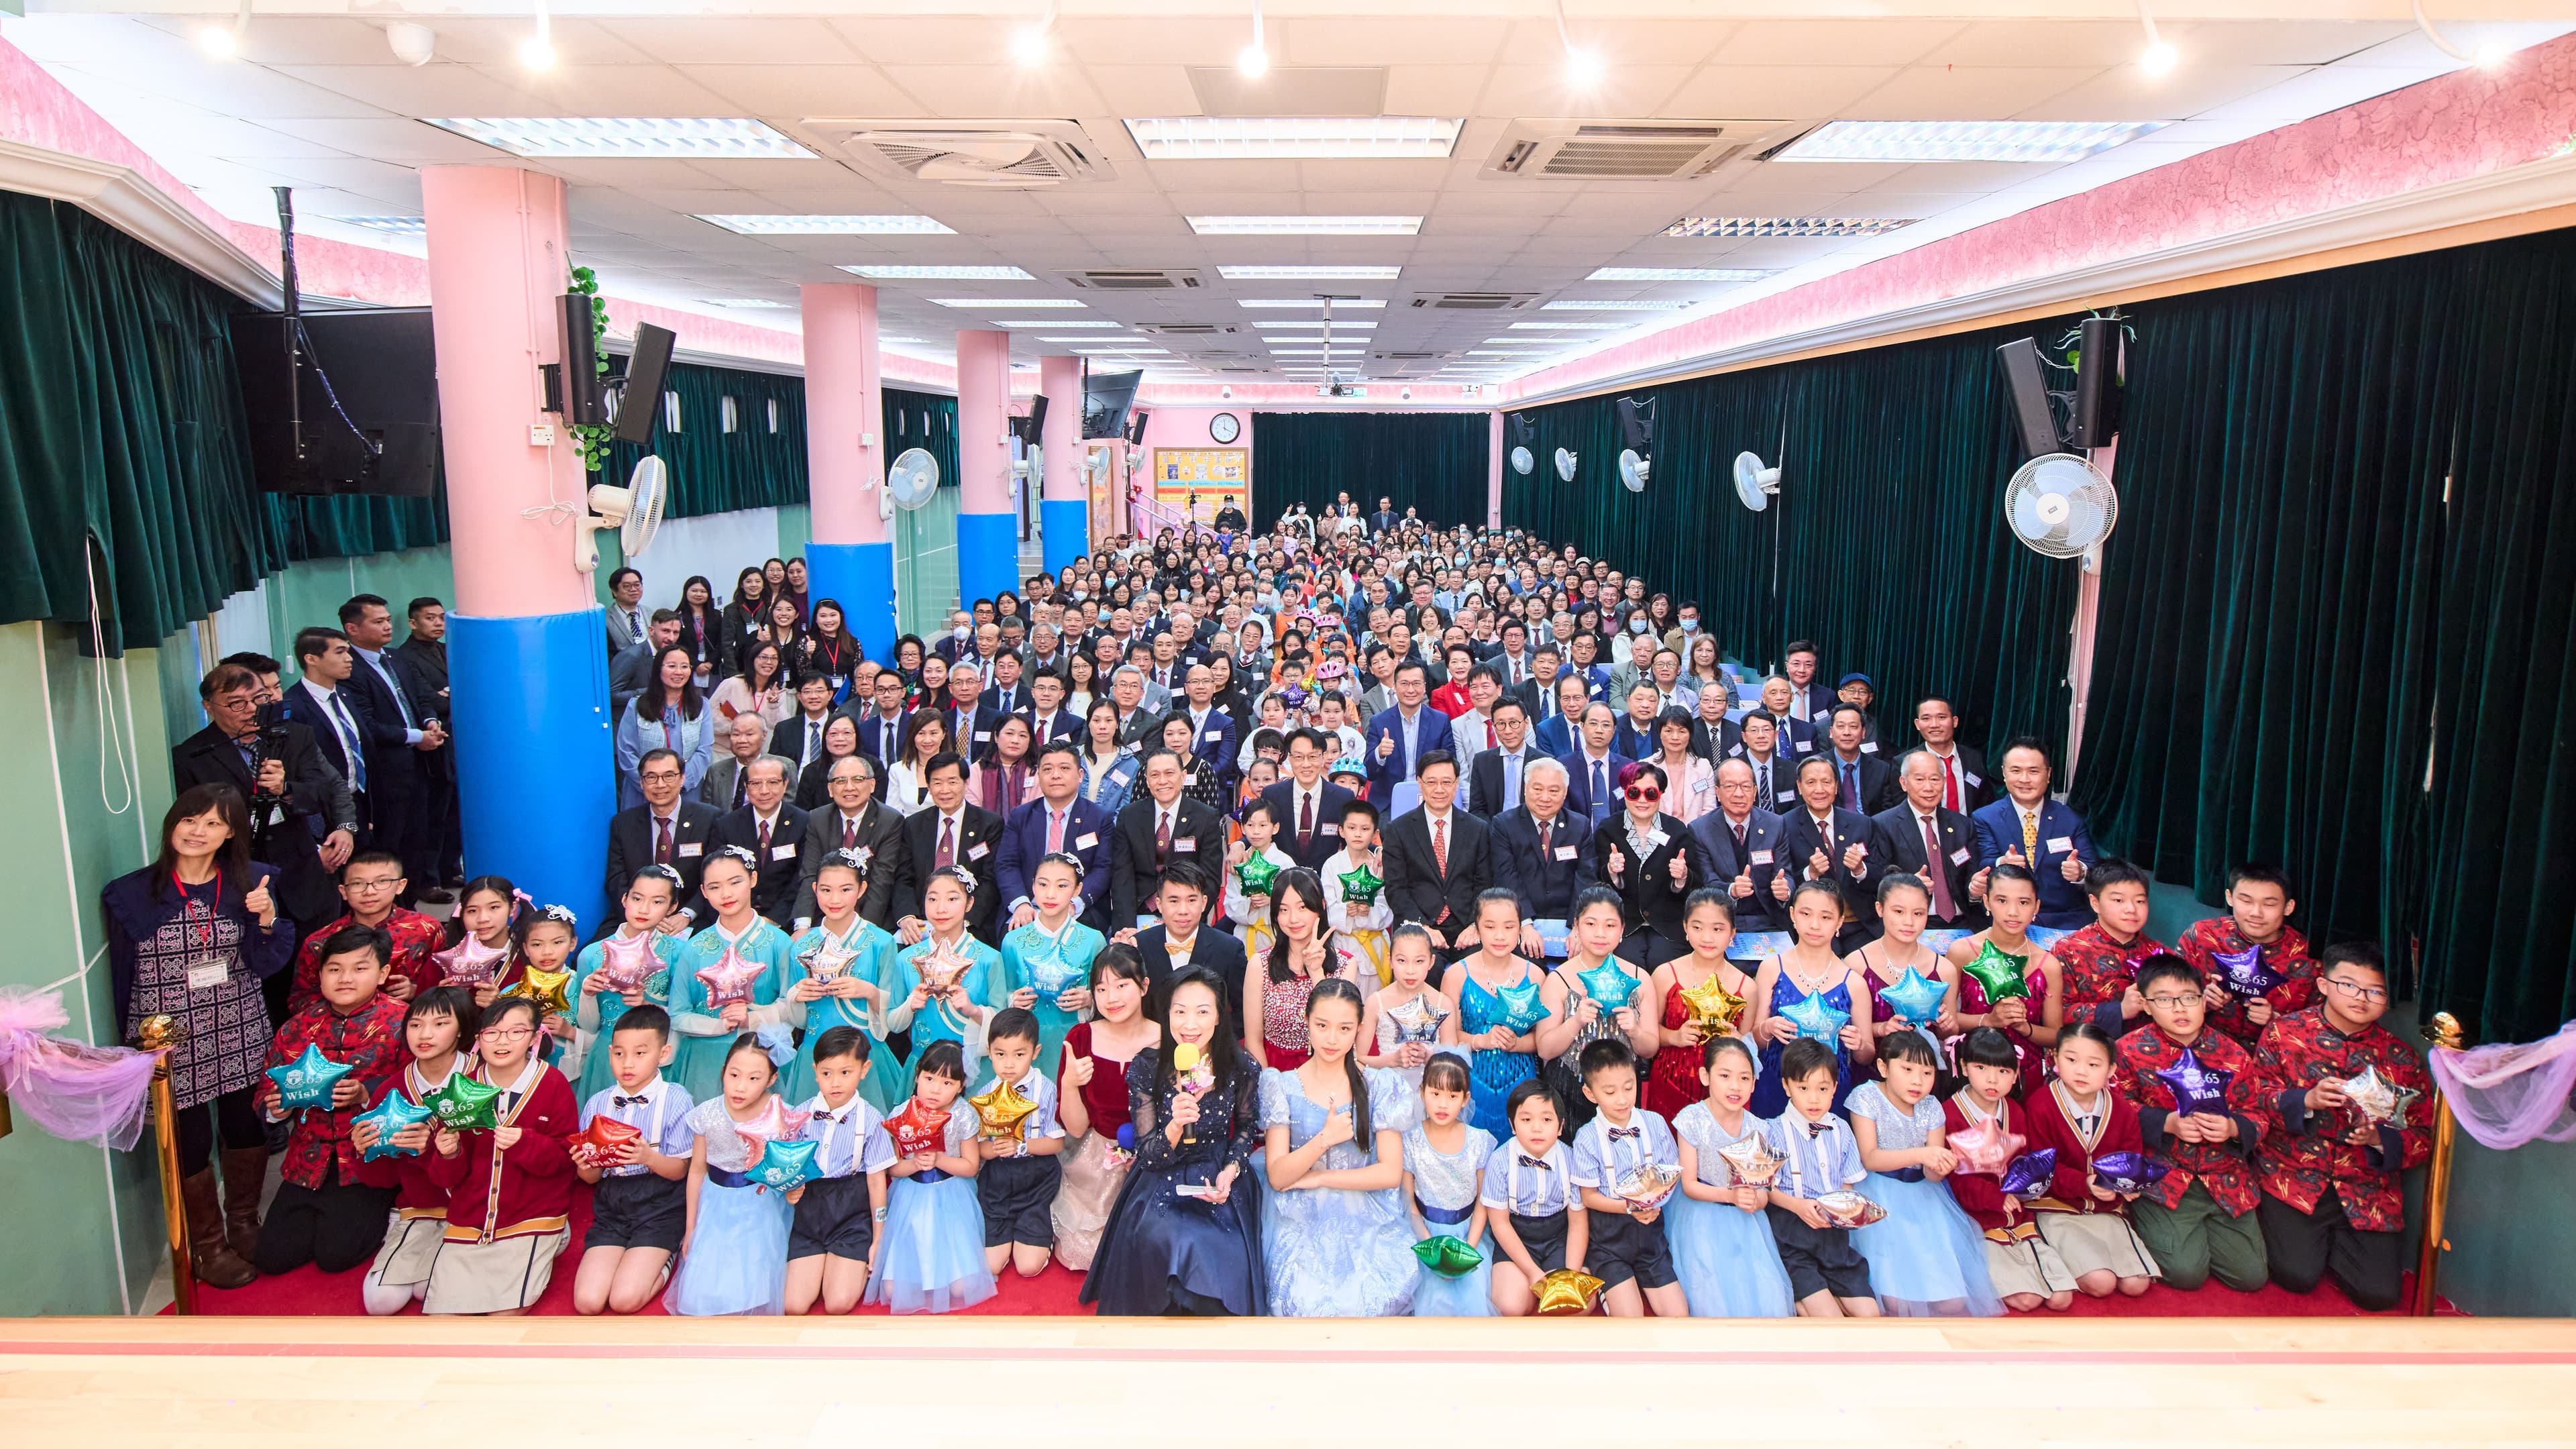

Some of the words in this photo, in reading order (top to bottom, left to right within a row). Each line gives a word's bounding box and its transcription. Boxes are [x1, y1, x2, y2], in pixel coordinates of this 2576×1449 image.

[1244, 878, 1263, 886] Wish
[470, 962, 483, 971] 65
[2002, 958, 2015, 967] 65
[452, 974, 479, 982] Wish
[609, 968, 635, 984] Wish
[2253, 975, 2267, 985] 65
[1034, 981, 1059, 991] Wish
[1615, 978, 1626, 987] 65
[2230, 981, 2259, 996] Wish
[718, 989, 744, 999] Wish
[1599, 992, 1623, 1001] Wish
[1526, 1011, 1538, 1020] 65
[1506, 1015, 1529, 1029] Wish
[1820, 1019, 1833, 1027] 65
[307, 1075, 323, 1084] 65
[2205, 1071, 2219, 1083] 65
[286, 1089, 319, 1101] Wish
[2189, 1088, 2220, 1100] Wish
[458, 1100, 474, 1112] 65
[443, 1116, 475, 1127] Wish
[1000, 1112, 1014, 1121] 65
[782, 1128, 795, 1140] 65
[917, 1126, 931, 1136] 65
[984, 1126, 1012, 1134] Wish
[600, 1143, 616, 1155] 65
[903, 1140, 931, 1151] Wish
[589, 1158, 617, 1167] Wish
[786, 1160, 800, 1174] 65
[776, 1174, 805, 1192] Wish
